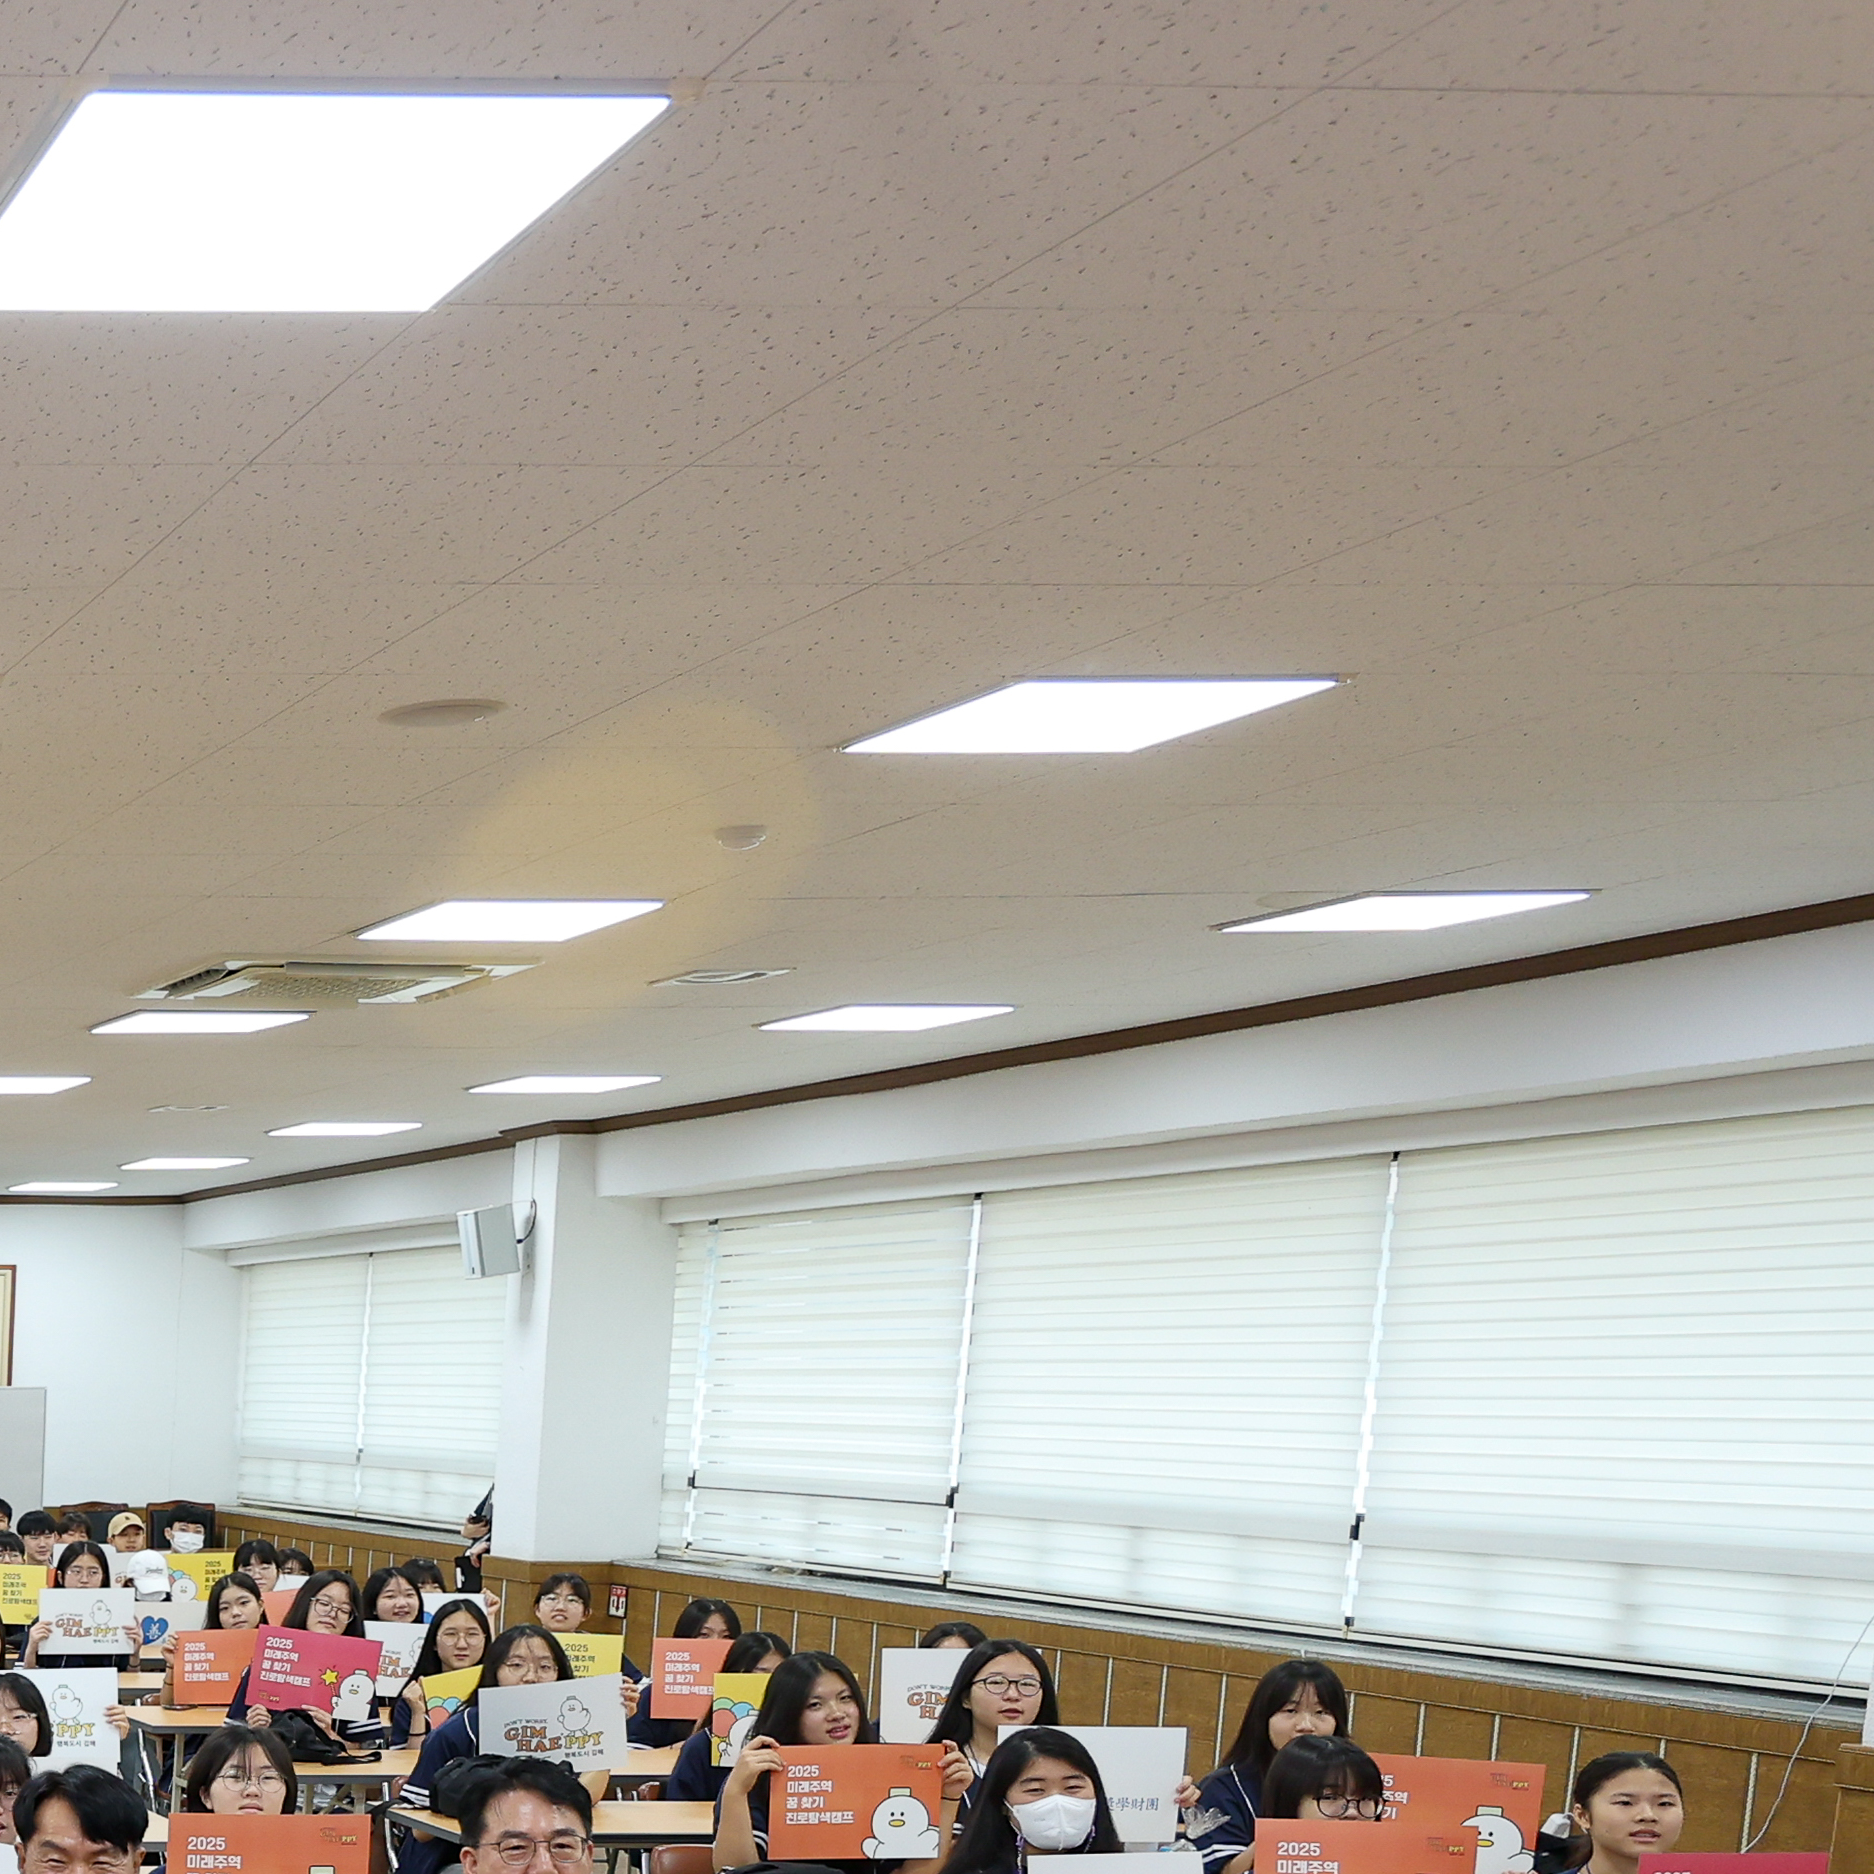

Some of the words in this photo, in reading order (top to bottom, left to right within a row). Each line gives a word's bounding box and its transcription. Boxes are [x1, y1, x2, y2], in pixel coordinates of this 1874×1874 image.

[266, 1637, 293, 1649] 2025
[264, 1649, 298, 1661] 미래주역
[262, 1660, 271, 1669] 꿈
[275, 1662, 290, 1672] 찾기
[260, 1671, 311, 1687] 진로탐색캠프
[504, 1725, 547, 1741] GIM
[188, 1837, 225, 1850] 2025
[1277, 1842, 1320, 1856] 2025
[187, 1855, 241, 1869] 미래주역
[1277, 1860, 1339, 1874] 미래주역
